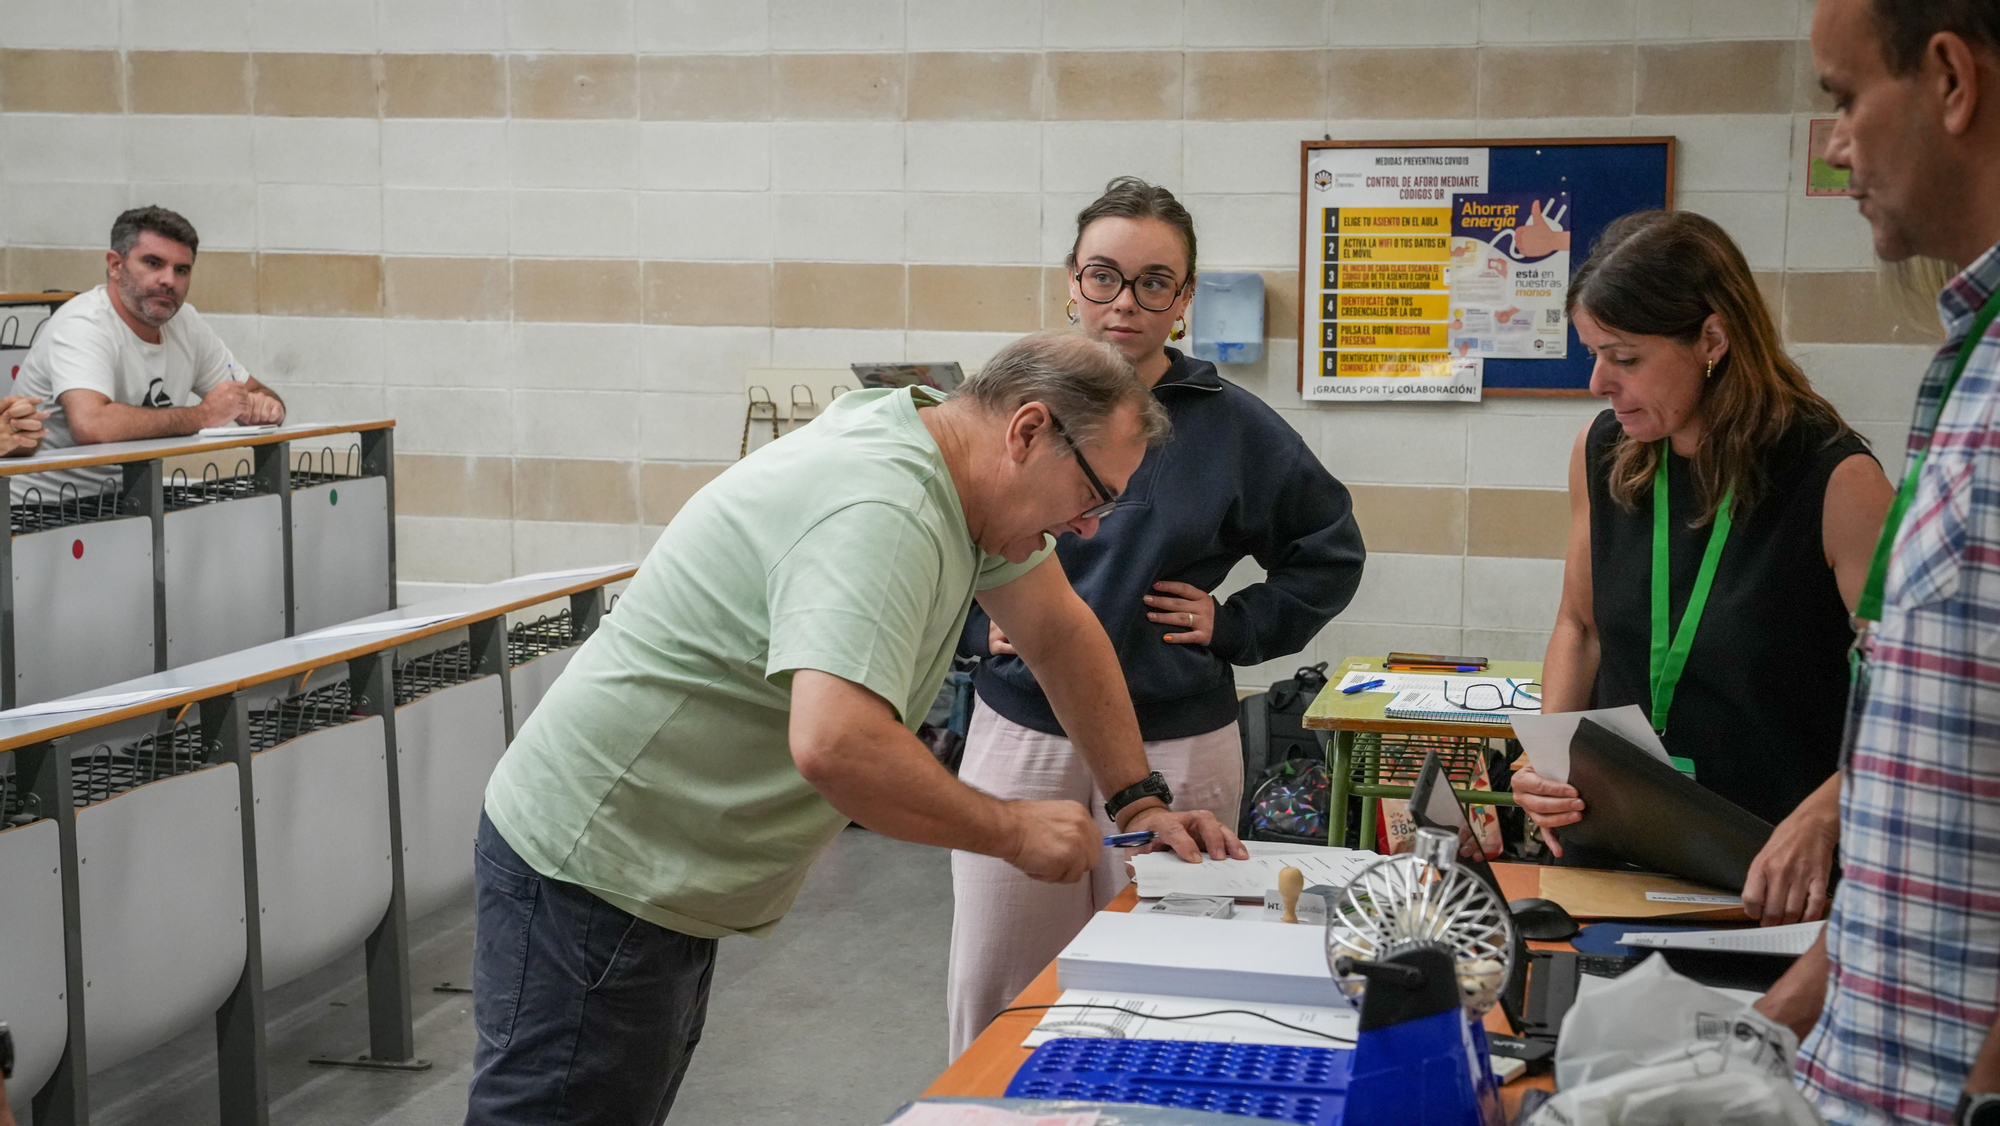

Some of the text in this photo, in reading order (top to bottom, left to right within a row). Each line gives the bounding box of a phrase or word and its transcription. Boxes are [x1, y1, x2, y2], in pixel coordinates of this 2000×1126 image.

[1375, 156, 1402, 166] MEDIDAS
[1404, 156, 1443, 166] PREVENTIVAS
[1366, 176, 1479, 188] CONTROL DE AFORO MEDIANTE
[1434, 189, 1444, 200] QR
[1462, 201, 1519, 215] Ahorrar
[1331, 216, 1336, 228] 1
[1344, 217, 1438, 226] ELIGE TU ASIENTO EN EL AULA
[1461, 214, 1516, 231] energía
[1328, 242, 1335, 254] 2
[1344, 238, 1446, 248] ACTIVA LA WIFI O TUS DATOS EN
[1344, 249, 1351, 258] EL
[1328, 270, 1334, 282] 3
[1516, 269, 1538, 278] está
[1516, 280, 1561, 288] nuestras
[1327, 301, 1333, 312] 4
[1386, 297, 1399, 306] CON
[1401, 297, 1413, 306] TUS
[1341, 307, 1422, 316] CREDENCIALES DE LA UCO
[1327, 329, 1333, 340] 5
[1341, 324, 1430, 335] PULSA EL BOTÓN REGISTRAR
[1341, 336, 1376, 345] PRESENCIA
[1327, 358, 1333, 369] 6
[1409, 354, 1416, 363] EN
[1418, 354, 1429, 363] LAS
[1340, 363, 1368, 372] COMUNES
[1370, 363, 1376, 372] AL
[1313, 384, 1476, 395] ¡GRACIAS POR TU COLABORACIÓN!
[1391, 824, 1408, 835] 38
